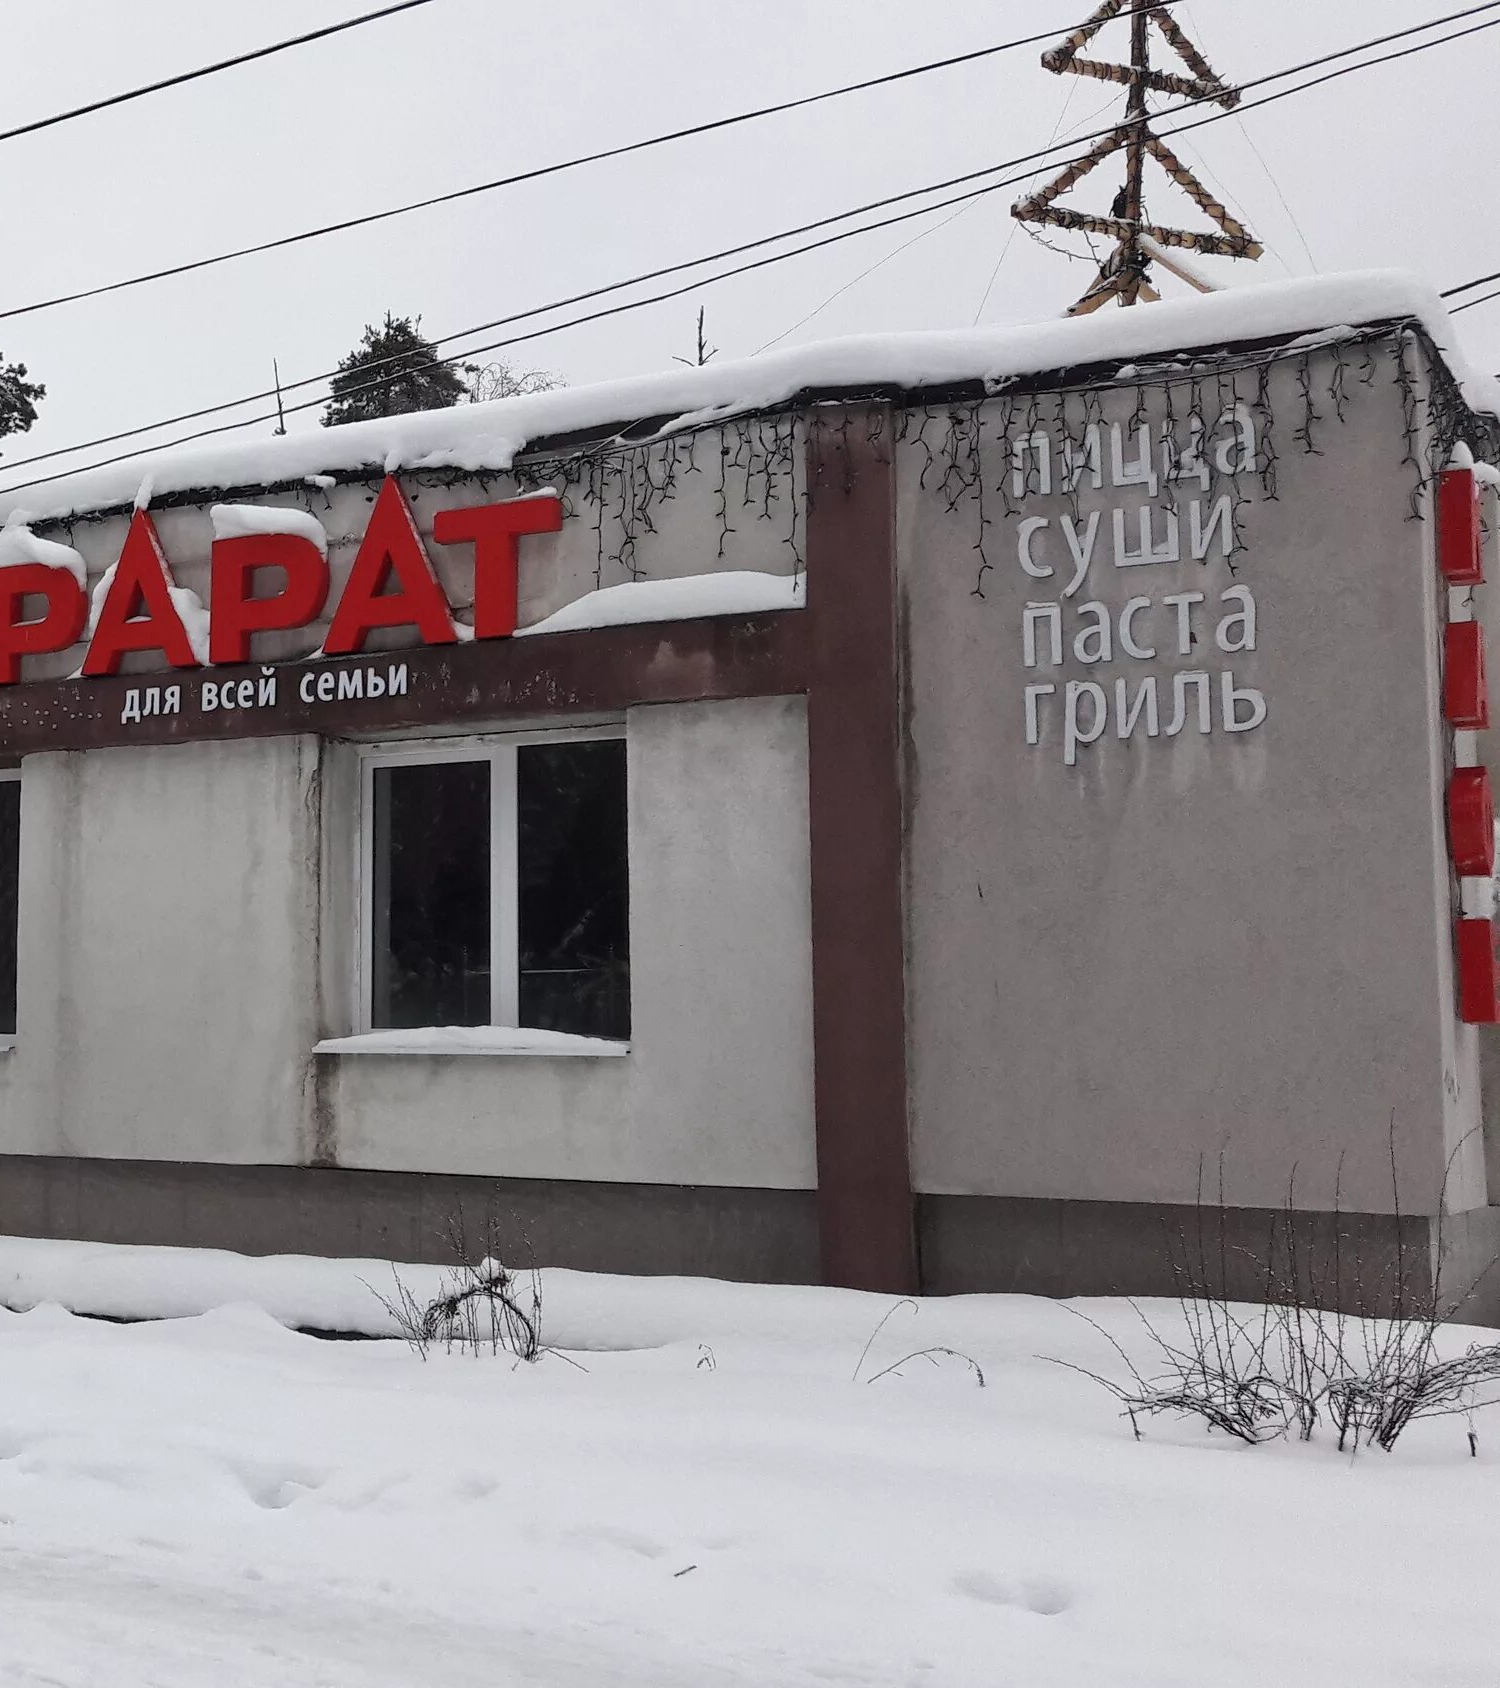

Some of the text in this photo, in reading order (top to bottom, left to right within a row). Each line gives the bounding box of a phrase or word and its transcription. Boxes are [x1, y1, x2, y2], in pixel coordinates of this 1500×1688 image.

[1012, 403, 1257, 498] пицца
[1017, 495, 1234, 599] суши
[1023, 584, 1257, 667] паста
[121, 663, 408, 725] для всей семьи
[1024, 670, 1268, 766] гриль
